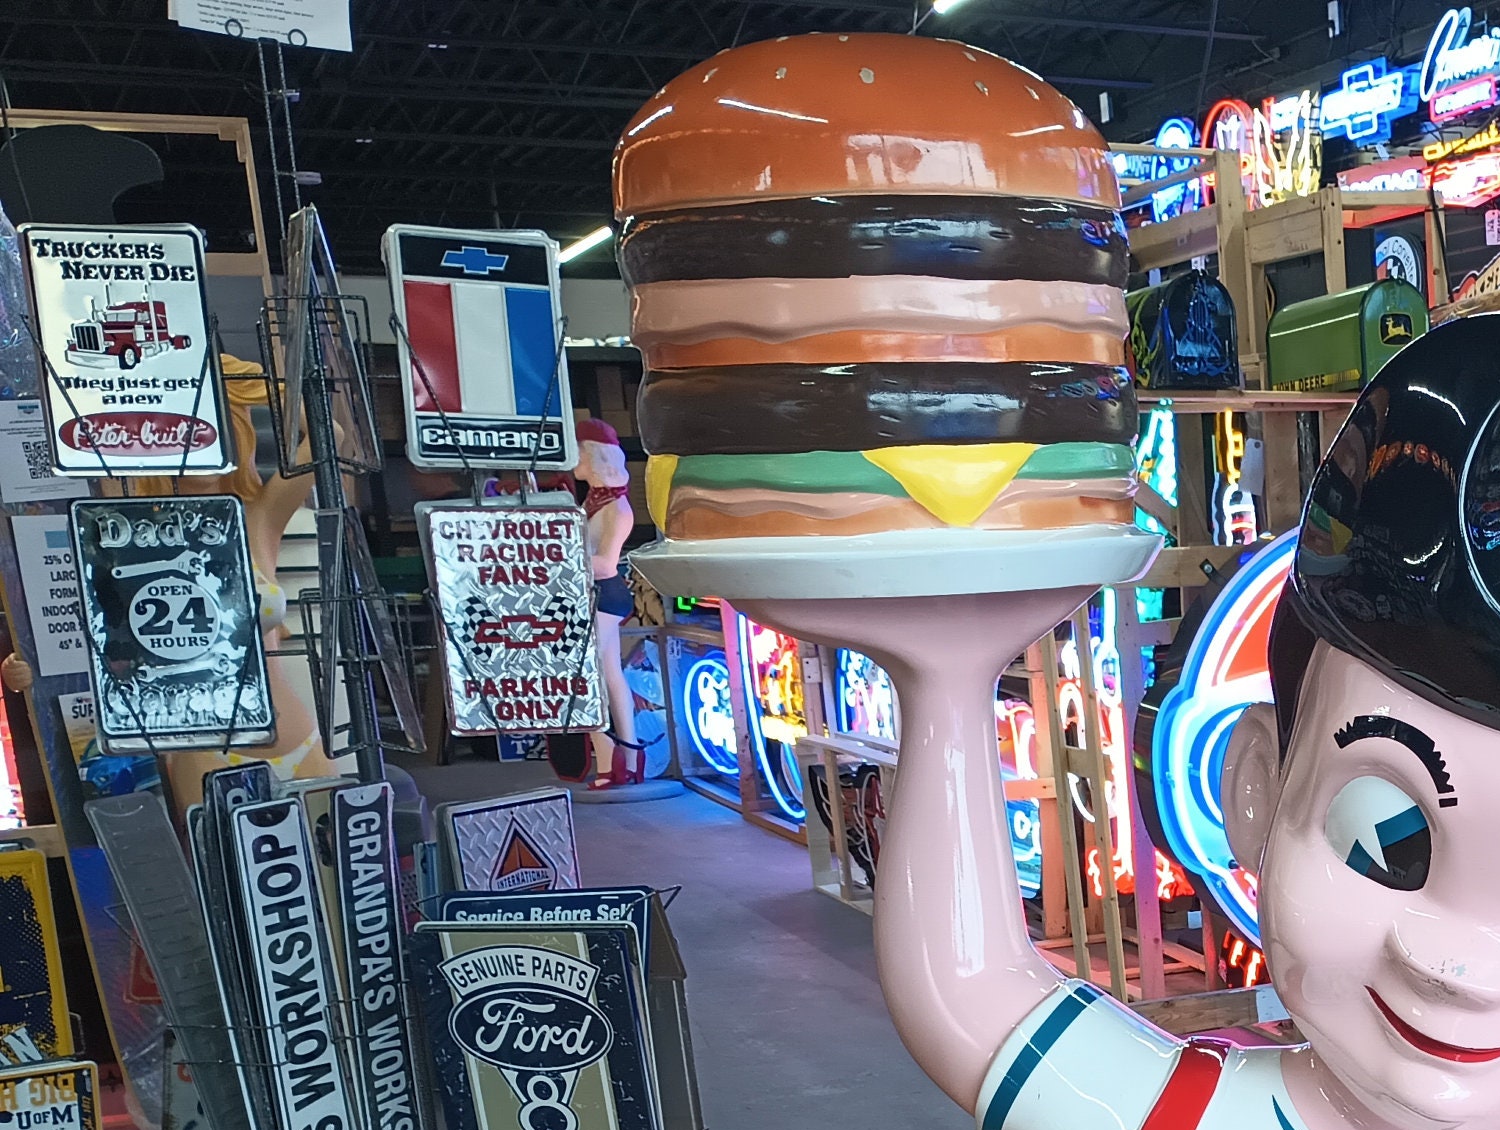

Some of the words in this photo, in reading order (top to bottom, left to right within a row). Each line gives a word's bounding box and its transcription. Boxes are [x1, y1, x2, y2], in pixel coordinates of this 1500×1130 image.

[32, 239, 165, 260] TRUCKERS
[61, 261, 146, 281] NEVER
[150, 263, 195, 282] DIE
[60, 376, 114, 392] They
[116, 376, 161, 392] just
[163, 377, 200, 391] get
[119, 394, 164, 405] new
[72, 416, 209, 449] Peter-built
[97, 510, 228, 548] Dad's
[457, 544, 565, 563] RACING
[479, 566, 549, 586] FANS
[49, 587, 78, 599] FORM
[148, 585, 193, 597] OPEN
[134, 597, 215, 636] 24
[150, 636, 210, 649] HOURS
[465, 677, 589, 698] PARKING
[495, 699, 564, 721] ONLY
[497, 870, 549, 889] INTERNATIONAL
[347, 810, 396, 1012] GRANDPA'S
[455, 908, 524, 922] Service
[530, 907, 592, 922] Before
[251, 832, 337, 1109] WORKSHOP
[450, 953, 527, 990] GENUINE
[531, 956, 589, 991] PARTS
[475, 997, 595, 1056] Ford
